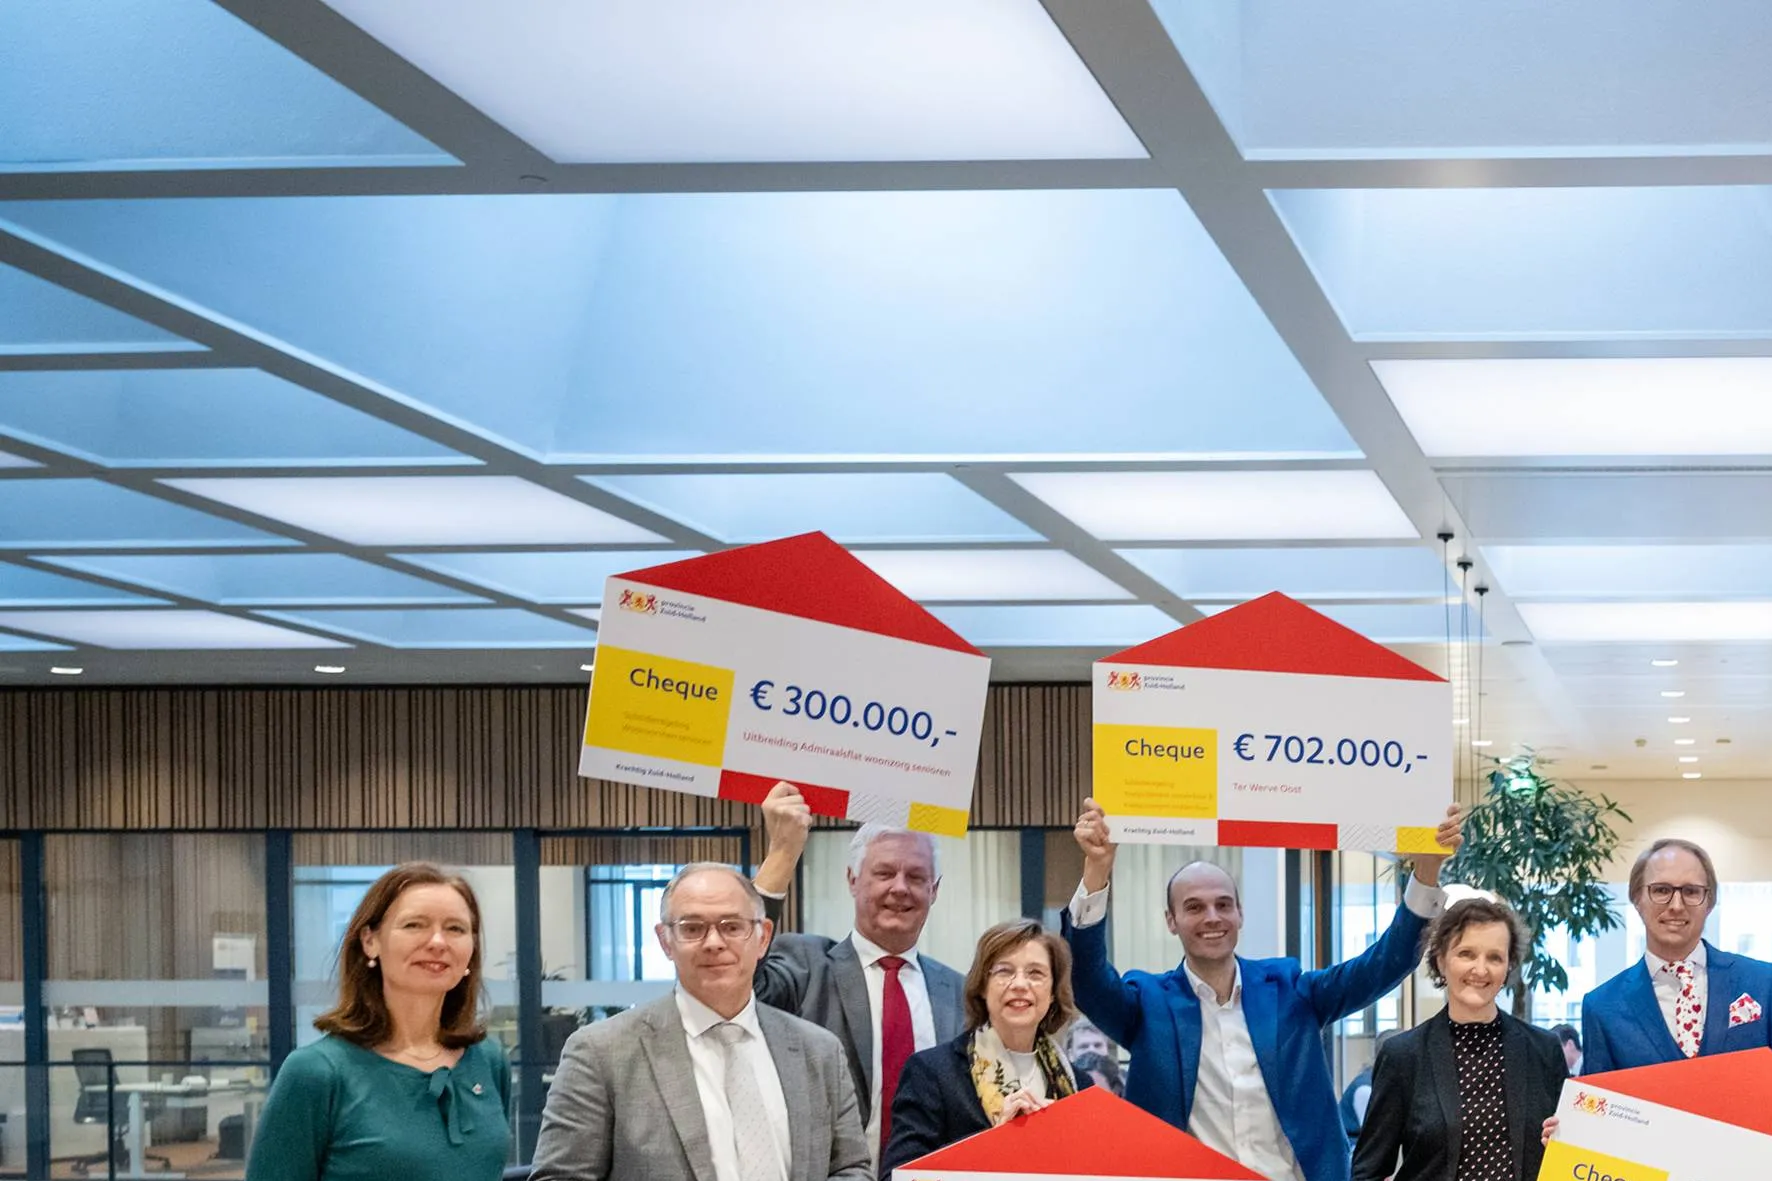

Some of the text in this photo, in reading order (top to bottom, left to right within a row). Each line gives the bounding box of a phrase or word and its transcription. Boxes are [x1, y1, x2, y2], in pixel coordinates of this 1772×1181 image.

[628, 667, 718, 701] Cheque
[748, 678, 957, 748] € 300.000,-
[742, 730, 951, 777] Uitbreiding Admiraalsflat woonzorg senioren
[1124, 736, 1205, 762] Cheque
[1232, 732, 1428, 774] € 702.000,-
